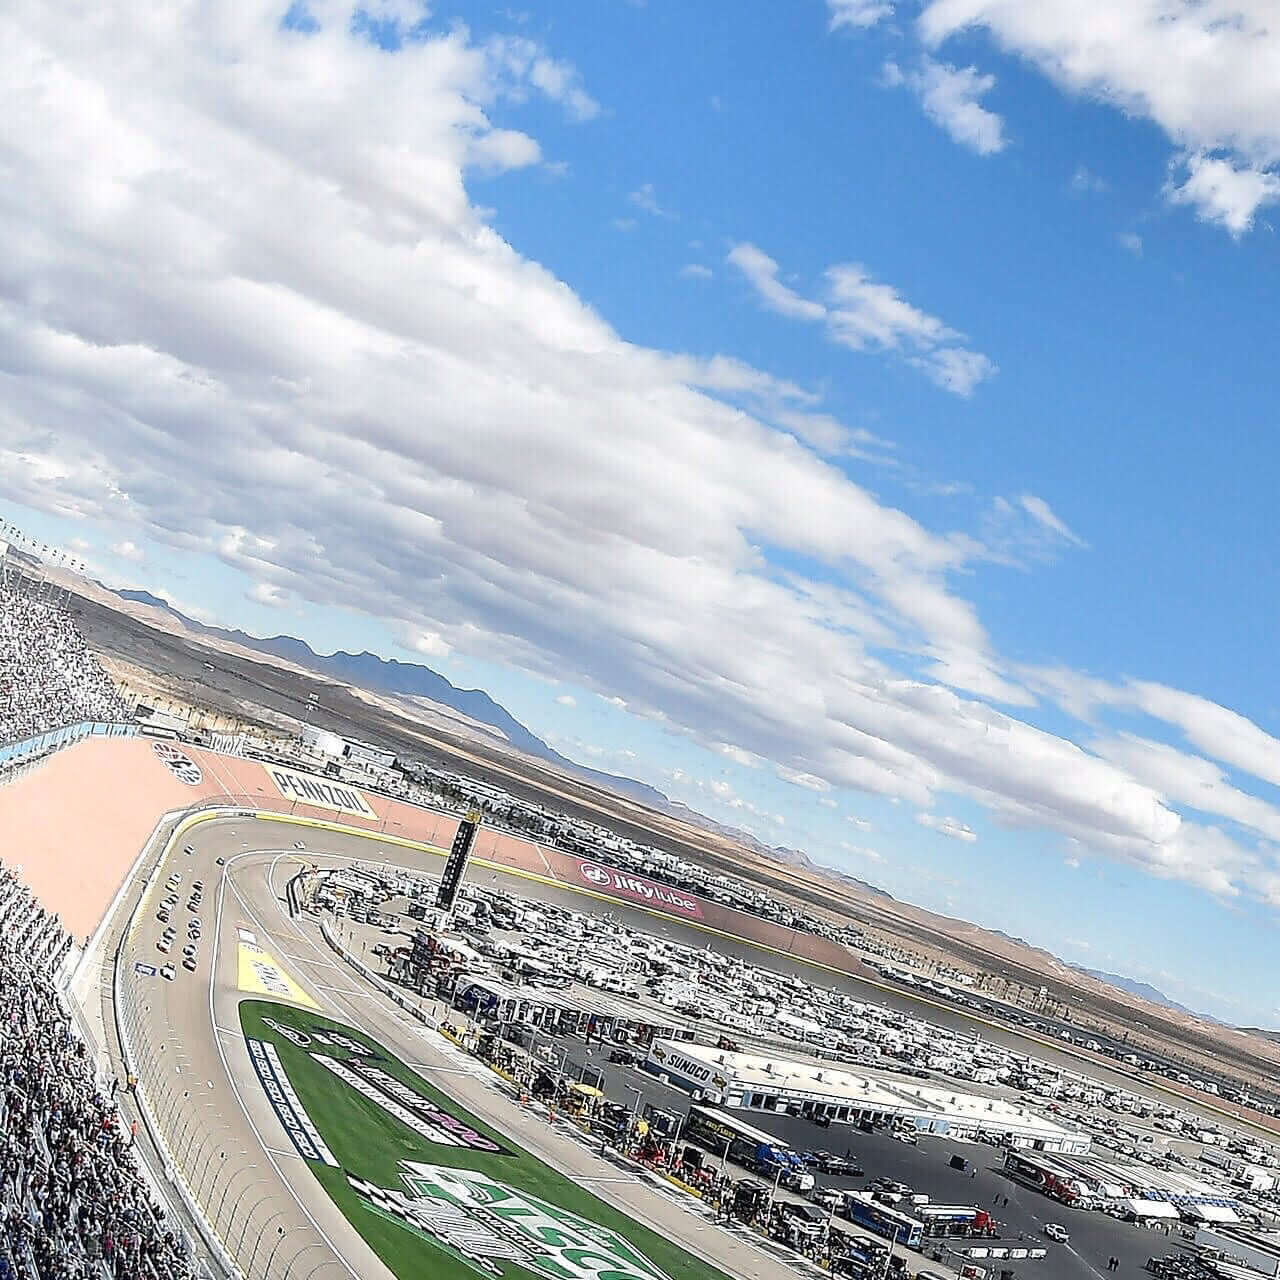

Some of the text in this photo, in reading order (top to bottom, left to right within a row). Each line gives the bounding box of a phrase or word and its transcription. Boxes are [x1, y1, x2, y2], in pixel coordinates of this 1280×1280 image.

[272, 770, 369, 814] PENNZOIL
[655, 887, 697, 911] lube
[667, 1055, 711, 1082] SUNOCO
